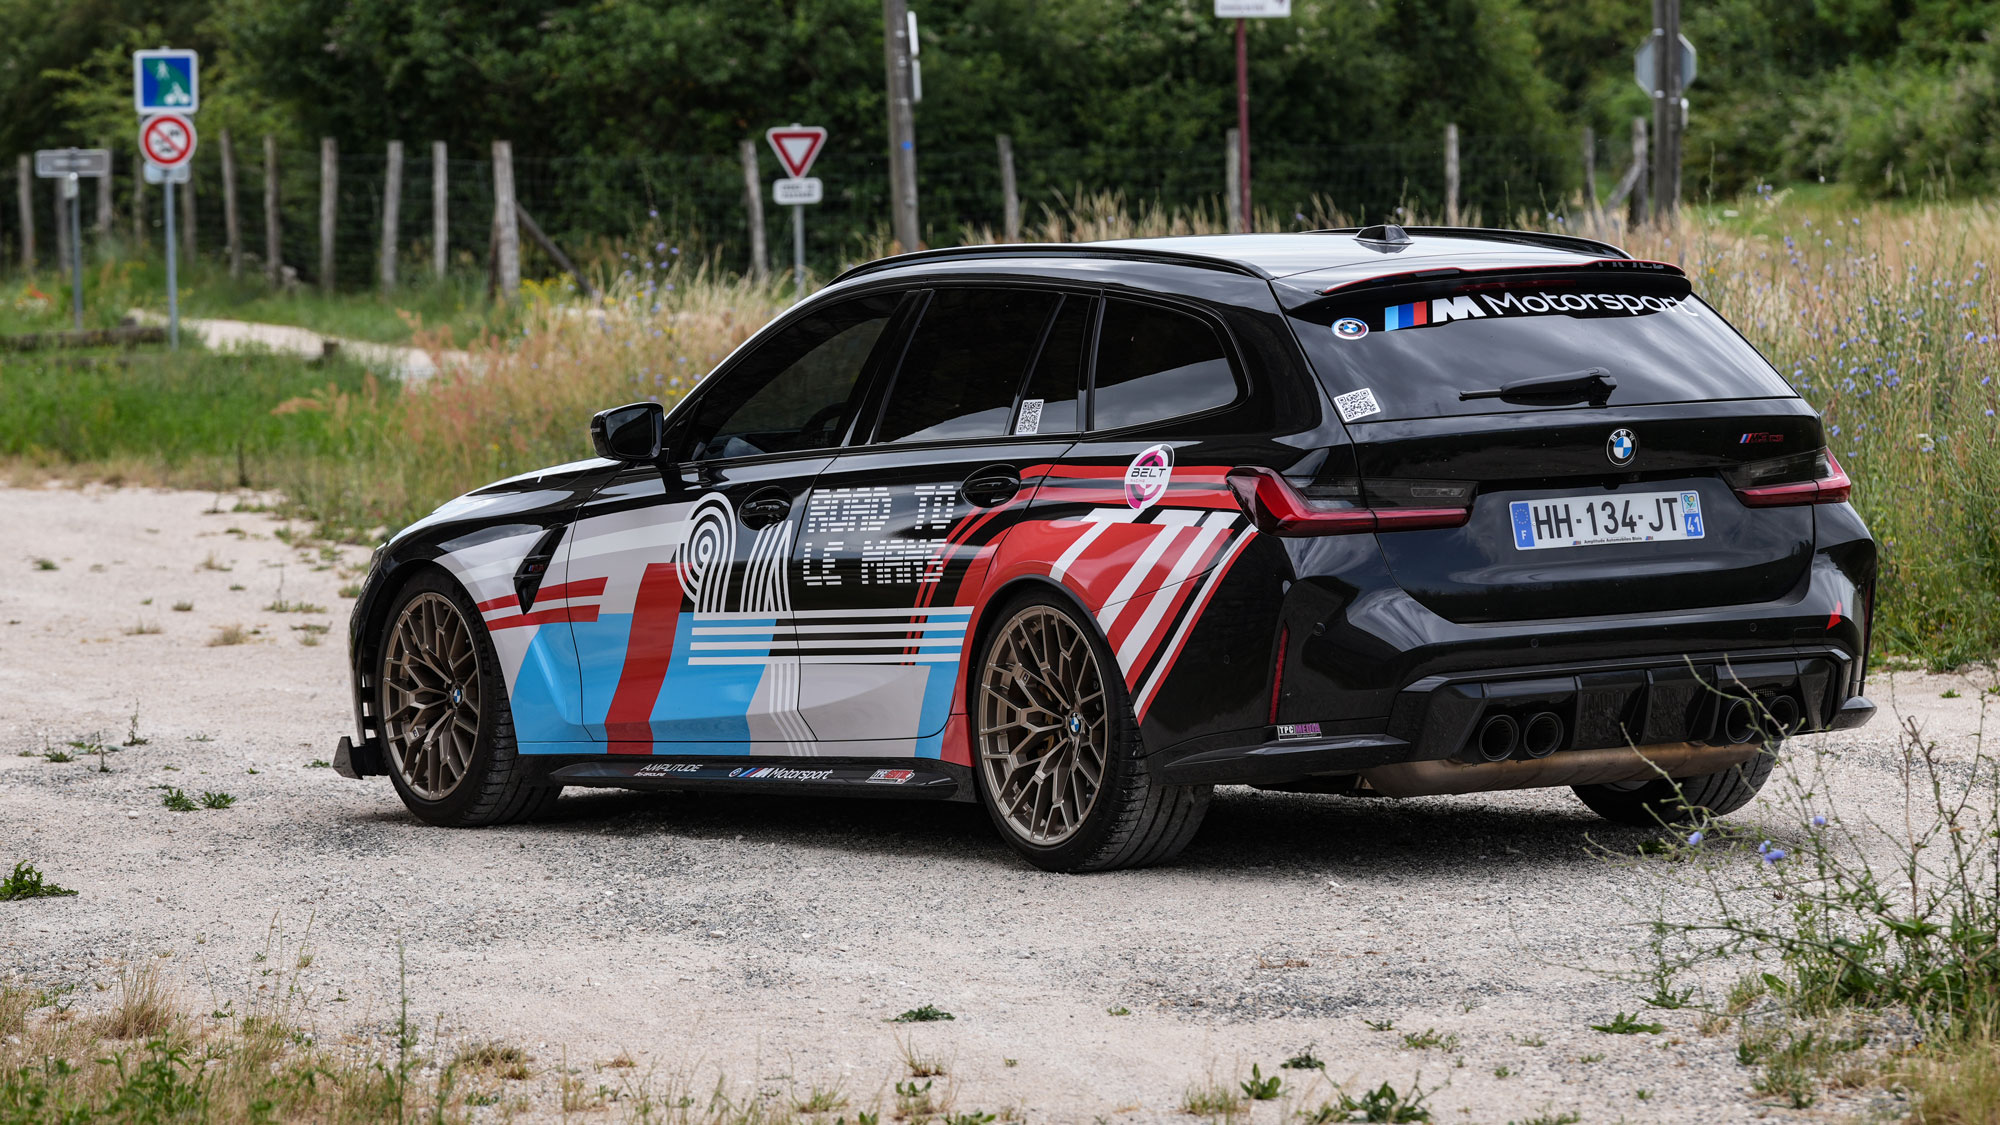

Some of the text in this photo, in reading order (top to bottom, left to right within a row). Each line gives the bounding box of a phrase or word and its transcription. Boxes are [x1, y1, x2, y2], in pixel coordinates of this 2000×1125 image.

[1480, 291, 1700, 317] Motorsport
[1131, 467, 1167, 478] BELT
[807, 485, 957, 533] ROAD TO
[1533, 497, 1678, 540] HH-134-JT
[1687, 516, 1701, 533] 41
[1521, 529, 1527, 541] F
[803, 538, 948, 586] LE MANS
[1280, 723, 1320, 734] TPC MEDIA
[640, 763, 703, 772] AMPLITUDE
[768, 767, 833, 781] Motorsport
